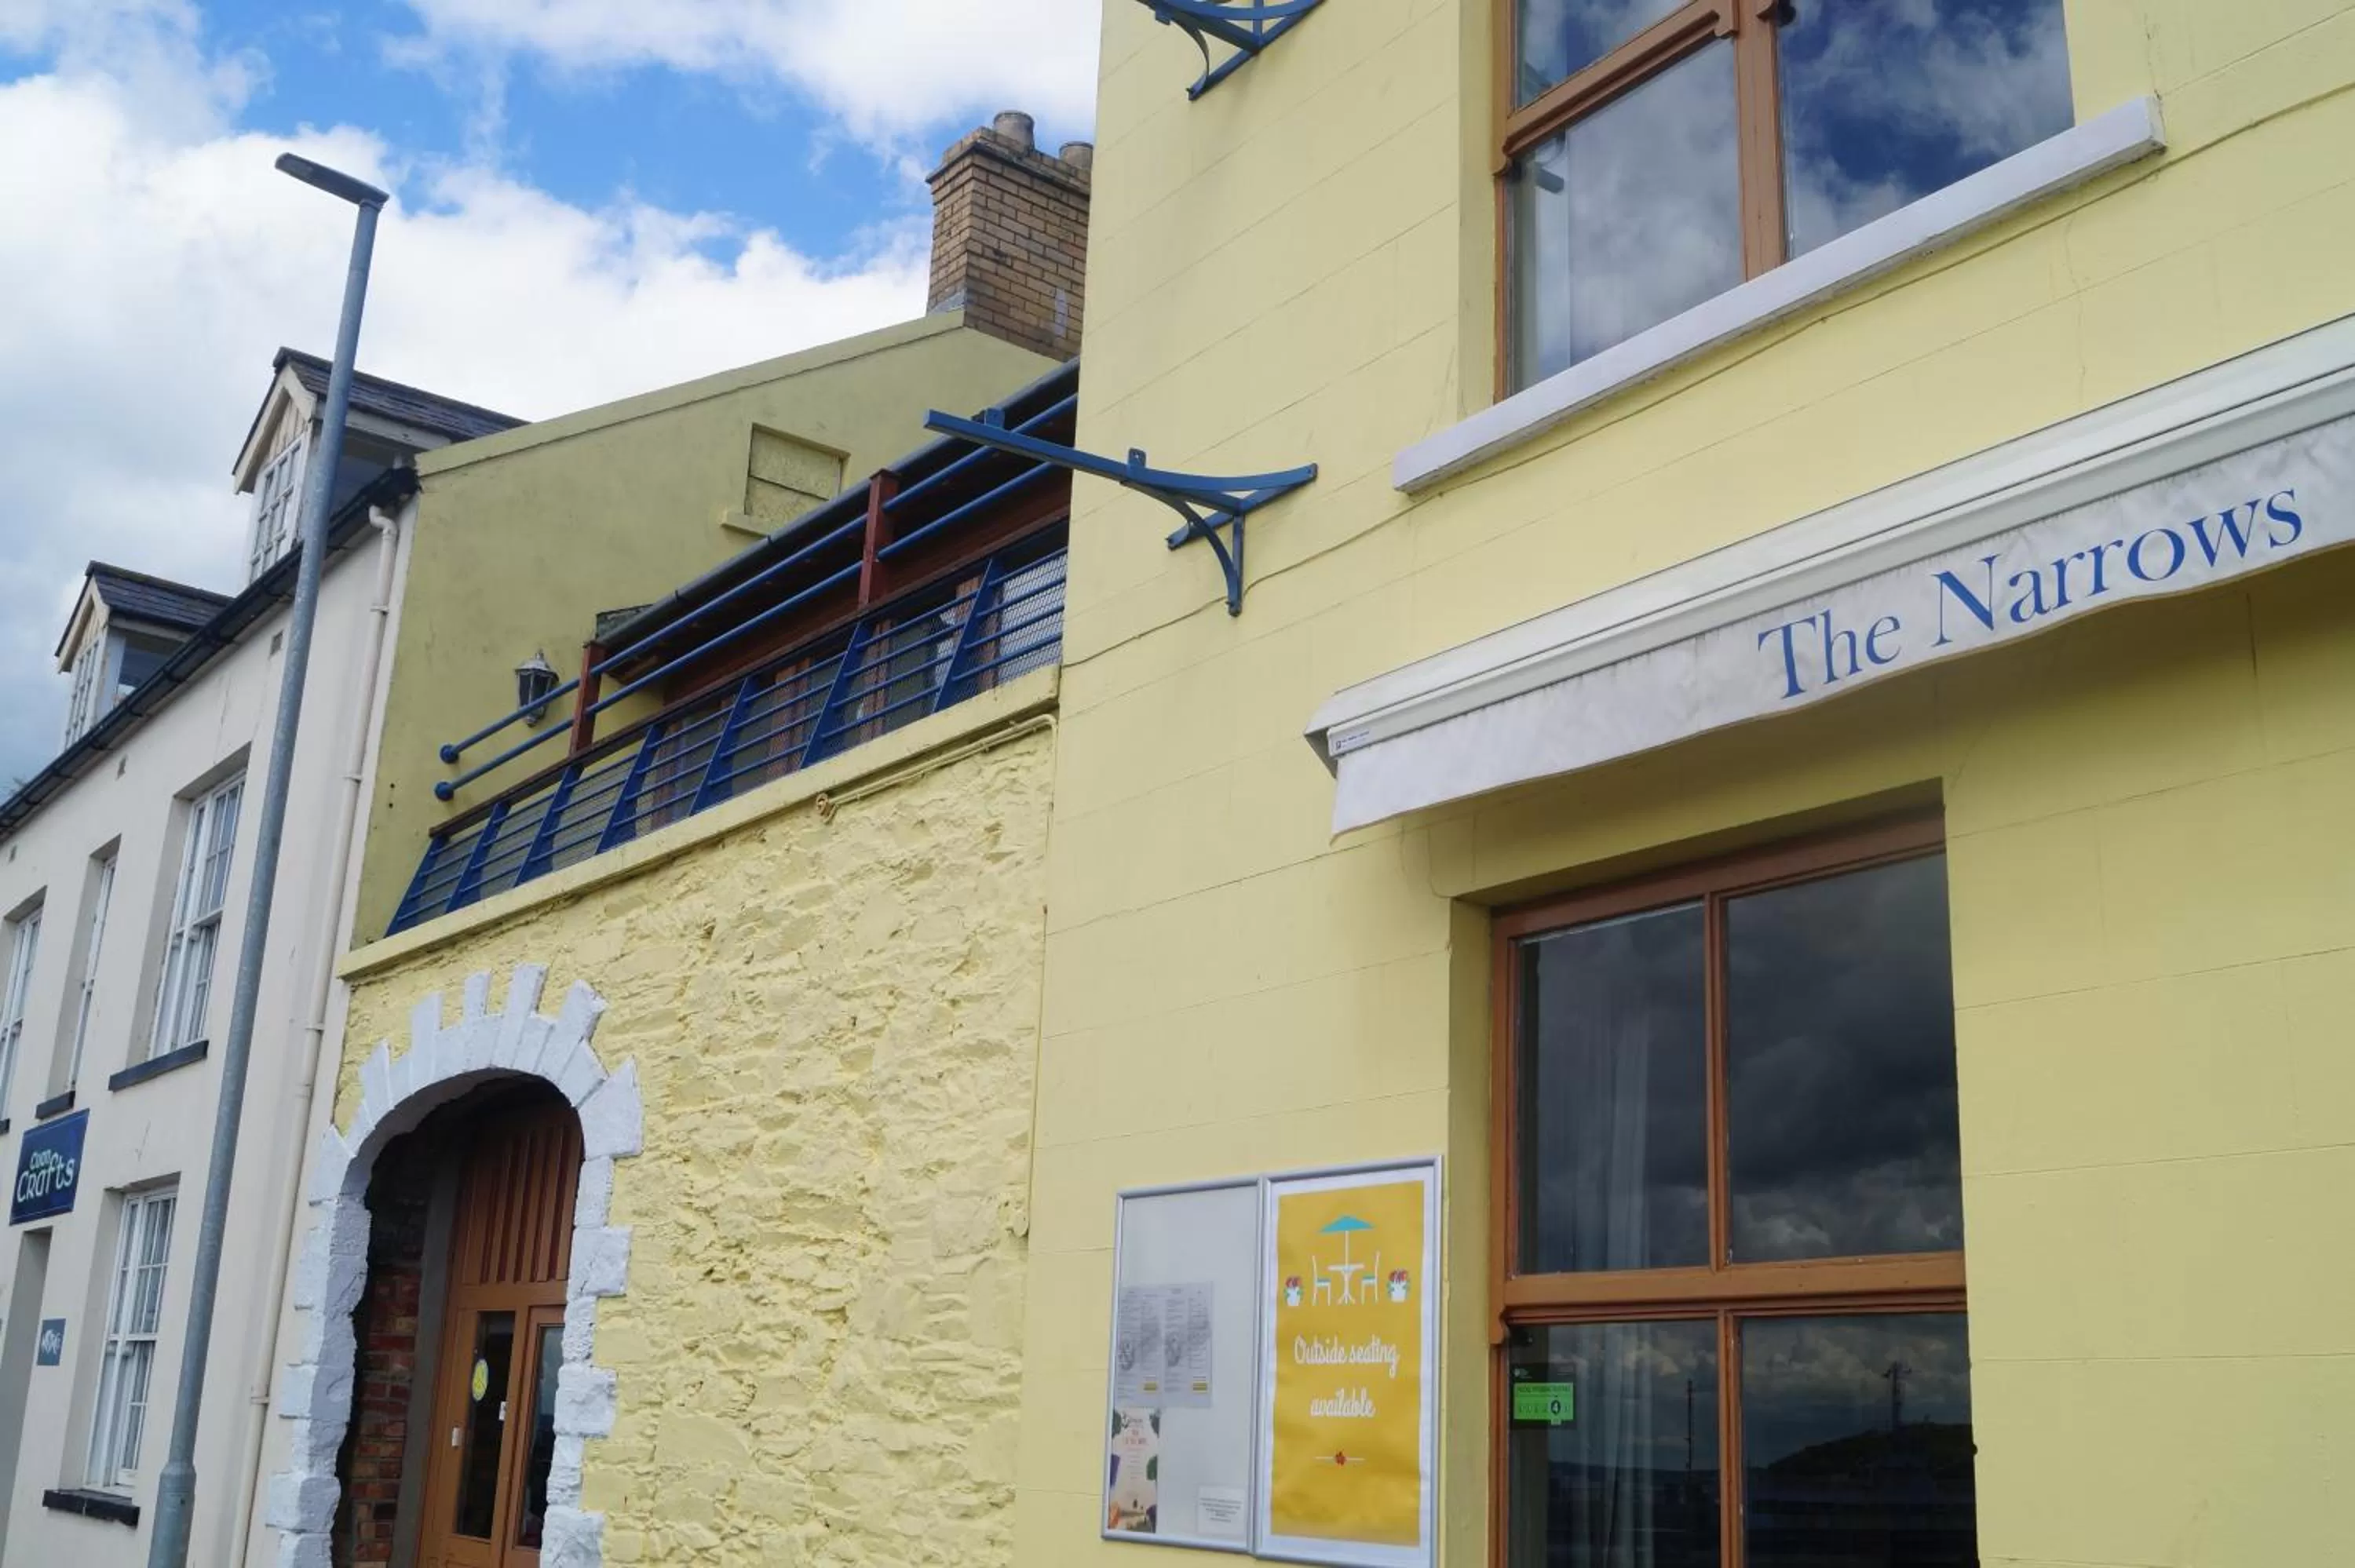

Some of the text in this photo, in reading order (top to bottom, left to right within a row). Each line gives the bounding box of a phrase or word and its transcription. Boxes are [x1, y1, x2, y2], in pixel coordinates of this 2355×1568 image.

[1758, 488, 2302, 699] The Narrows
[1294, 1333, 1400, 1379] Outside seating
[1310, 1387, 1376, 1418] available
